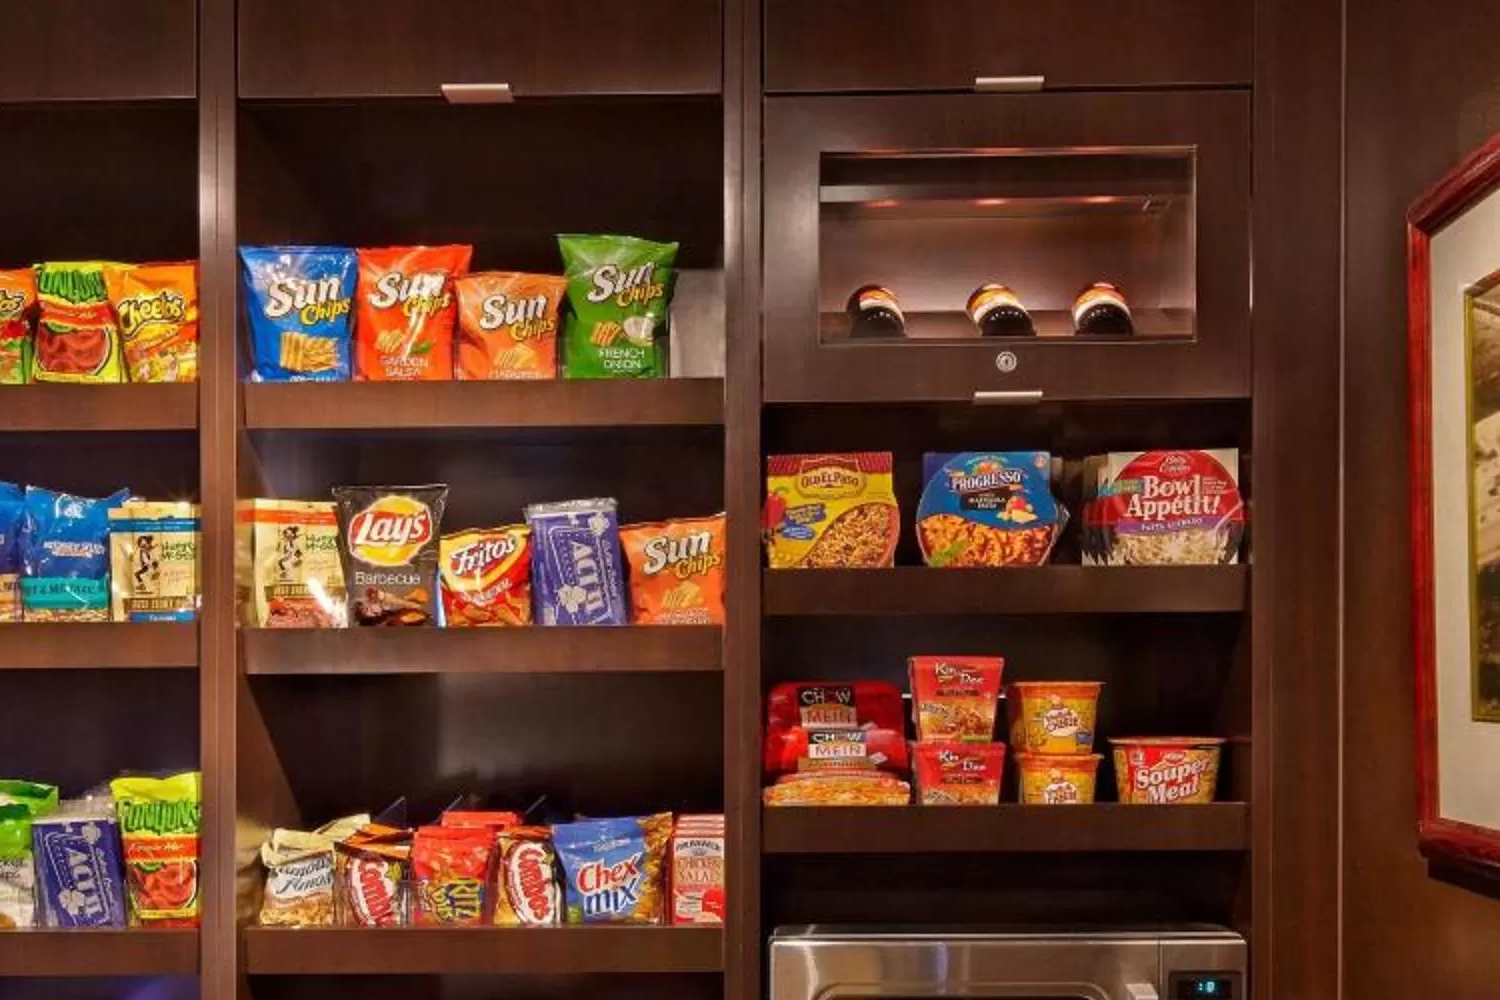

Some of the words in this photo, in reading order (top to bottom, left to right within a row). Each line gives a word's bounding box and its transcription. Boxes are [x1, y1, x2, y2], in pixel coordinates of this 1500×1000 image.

[267, 273, 341, 318] Sun
[370, 272, 445, 308] Sun
[588, 262, 654, 302] Sun
[616, 284, 663, 307] Chips
[117, 291, 186, 336] Cheetos
[301, 300, 350, 325] Chips
[403, 293, 450, 318] Chips
[480, 295, 547, 330] Sun
[512, 317, 556, 340] Chips
[1142, 474, 1200, 499] Bowl
[1122, 494, 1222, 521] Appétit!
[356, 508, 427, 546] Lay's
[451, 533, 517, 576] Fritos
[643, 531, 712, 575] Sun
[675, 554, 721, 579] Chips
[355, 571, 421, 585] Barbecue
[1135, 757, 1210, 789] Souper
[1147, 774, 1200, 804] Meal
[577, 852, 644, 893] Chex
